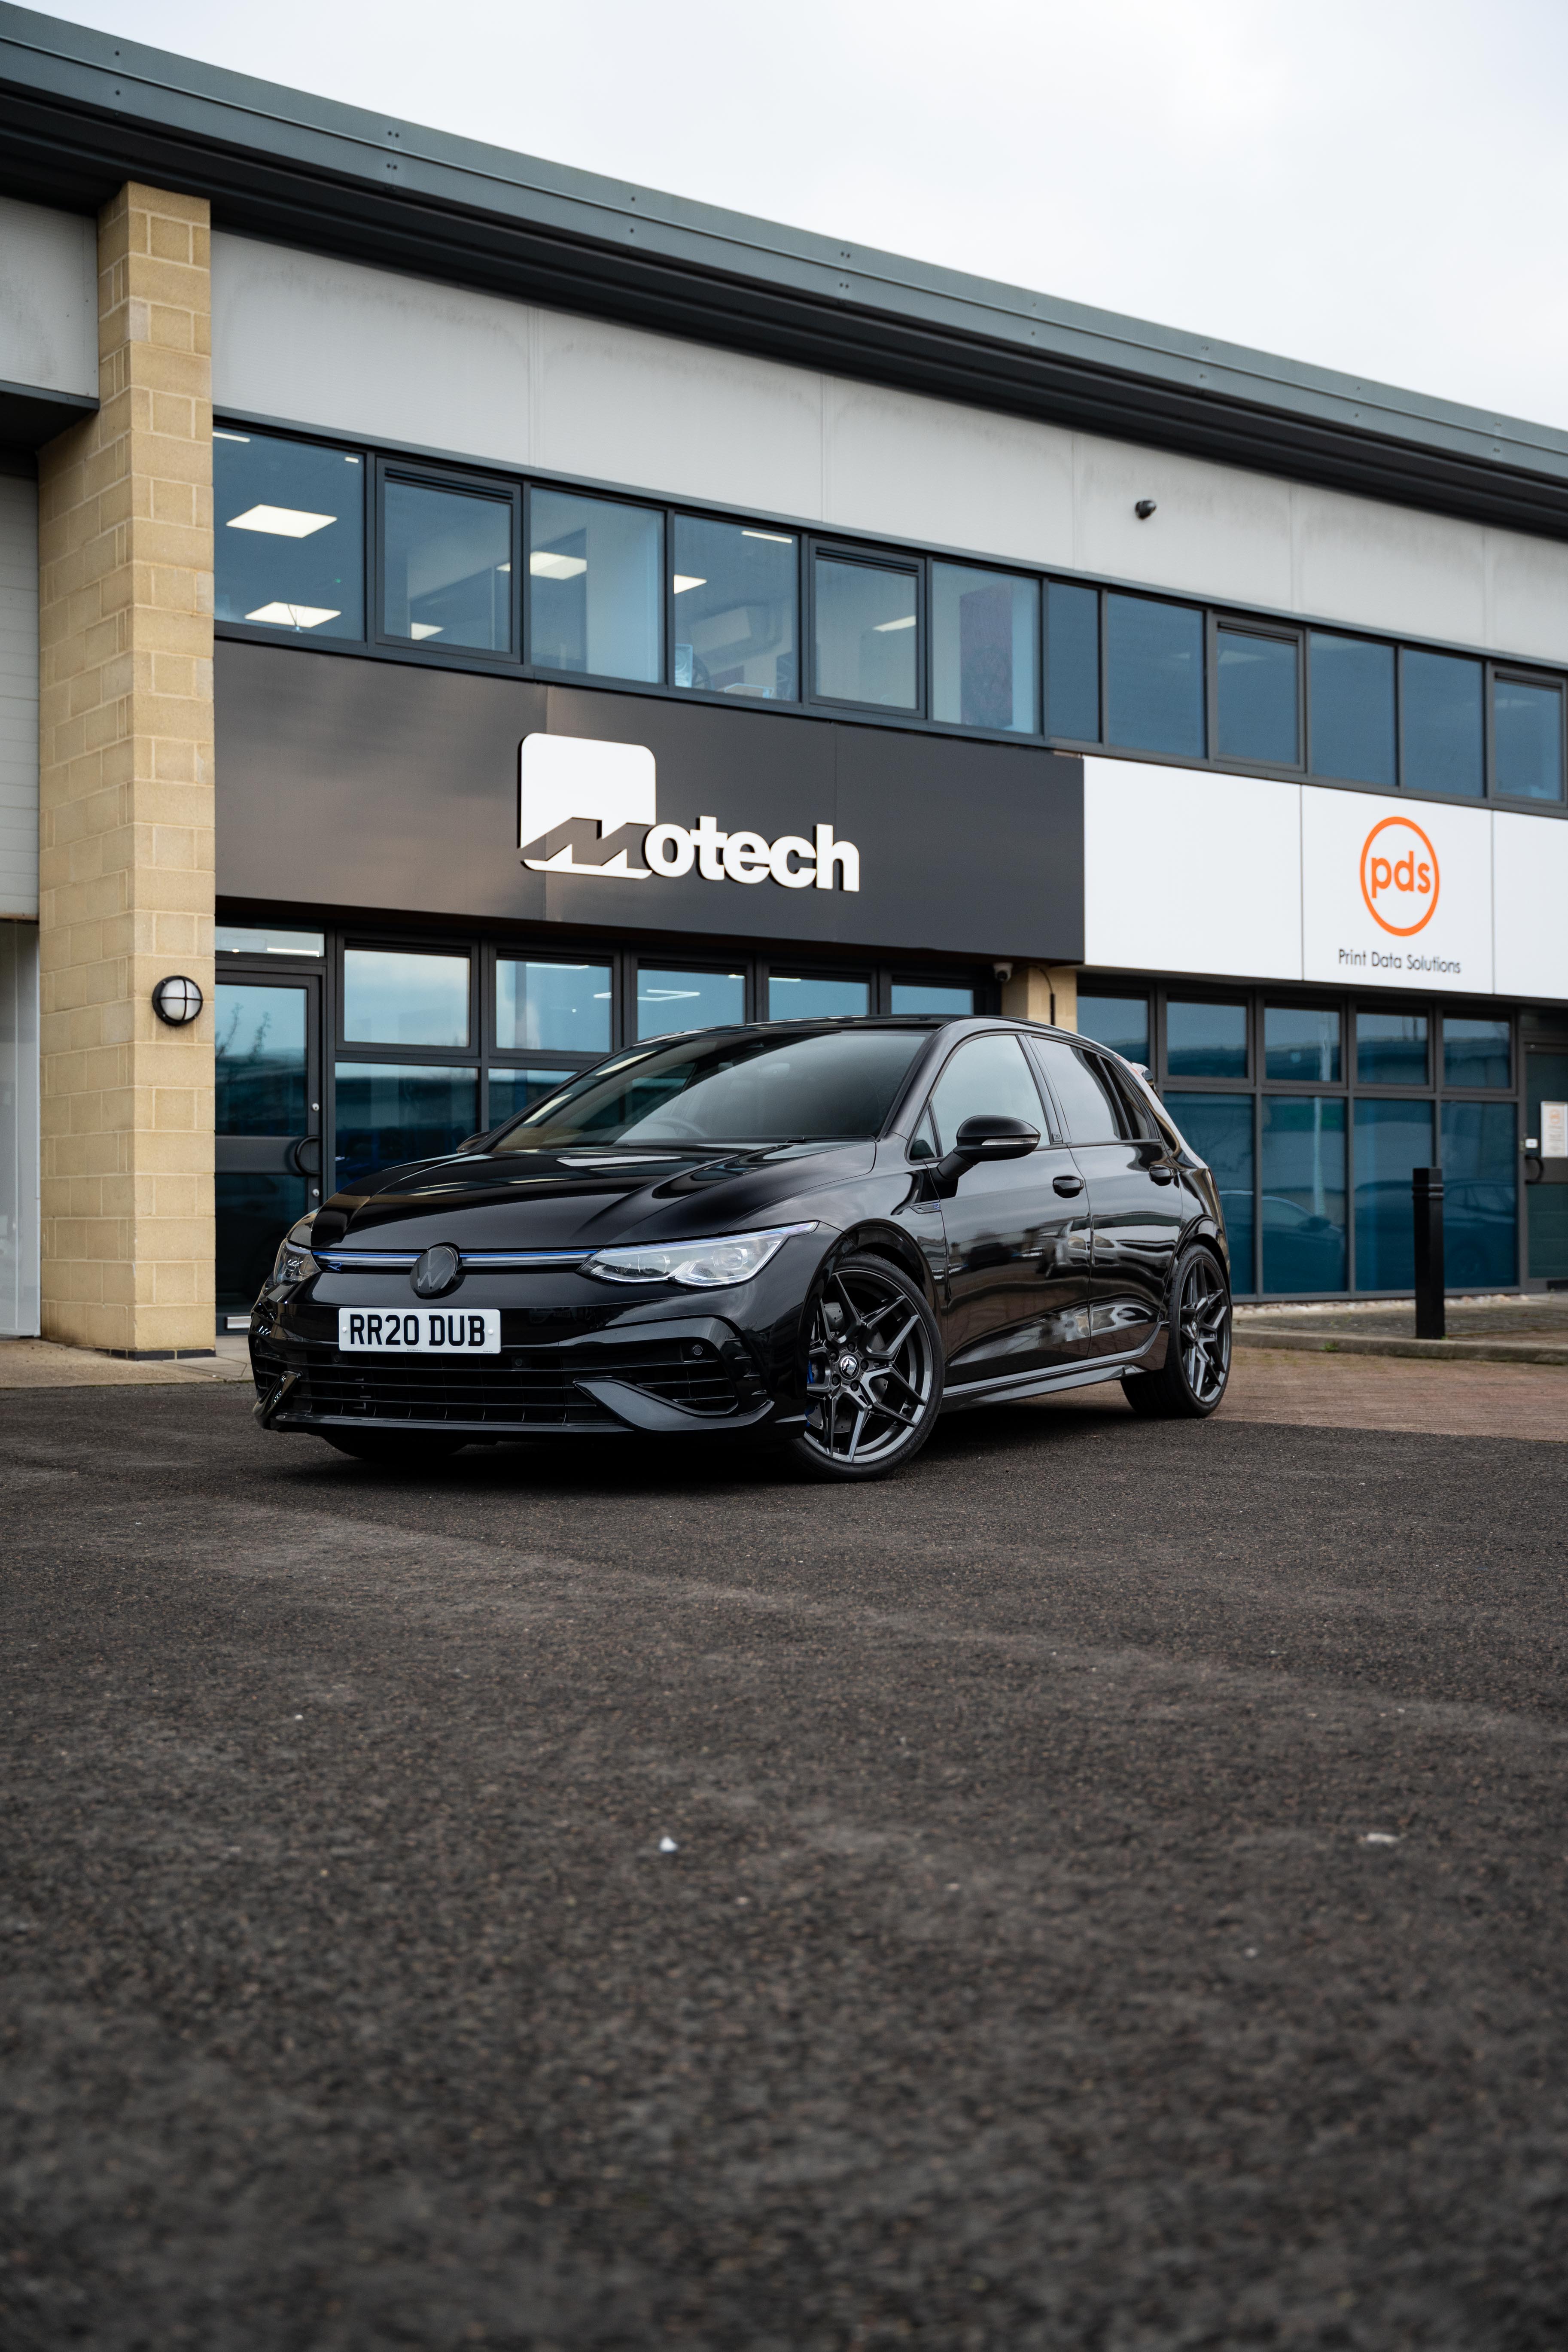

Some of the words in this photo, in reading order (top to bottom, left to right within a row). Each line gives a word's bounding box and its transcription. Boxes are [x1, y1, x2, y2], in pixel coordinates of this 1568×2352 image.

[1371, 851, 1431, 898] pds
[1338, 949, 1366, 966] Print
[1372, 952, 1402, 968] Data
[1407, 954, 1461, 974] Solutions
[350, 1314, 419, 1345] RR20
[429, 1315, 485, 1347] DUB
